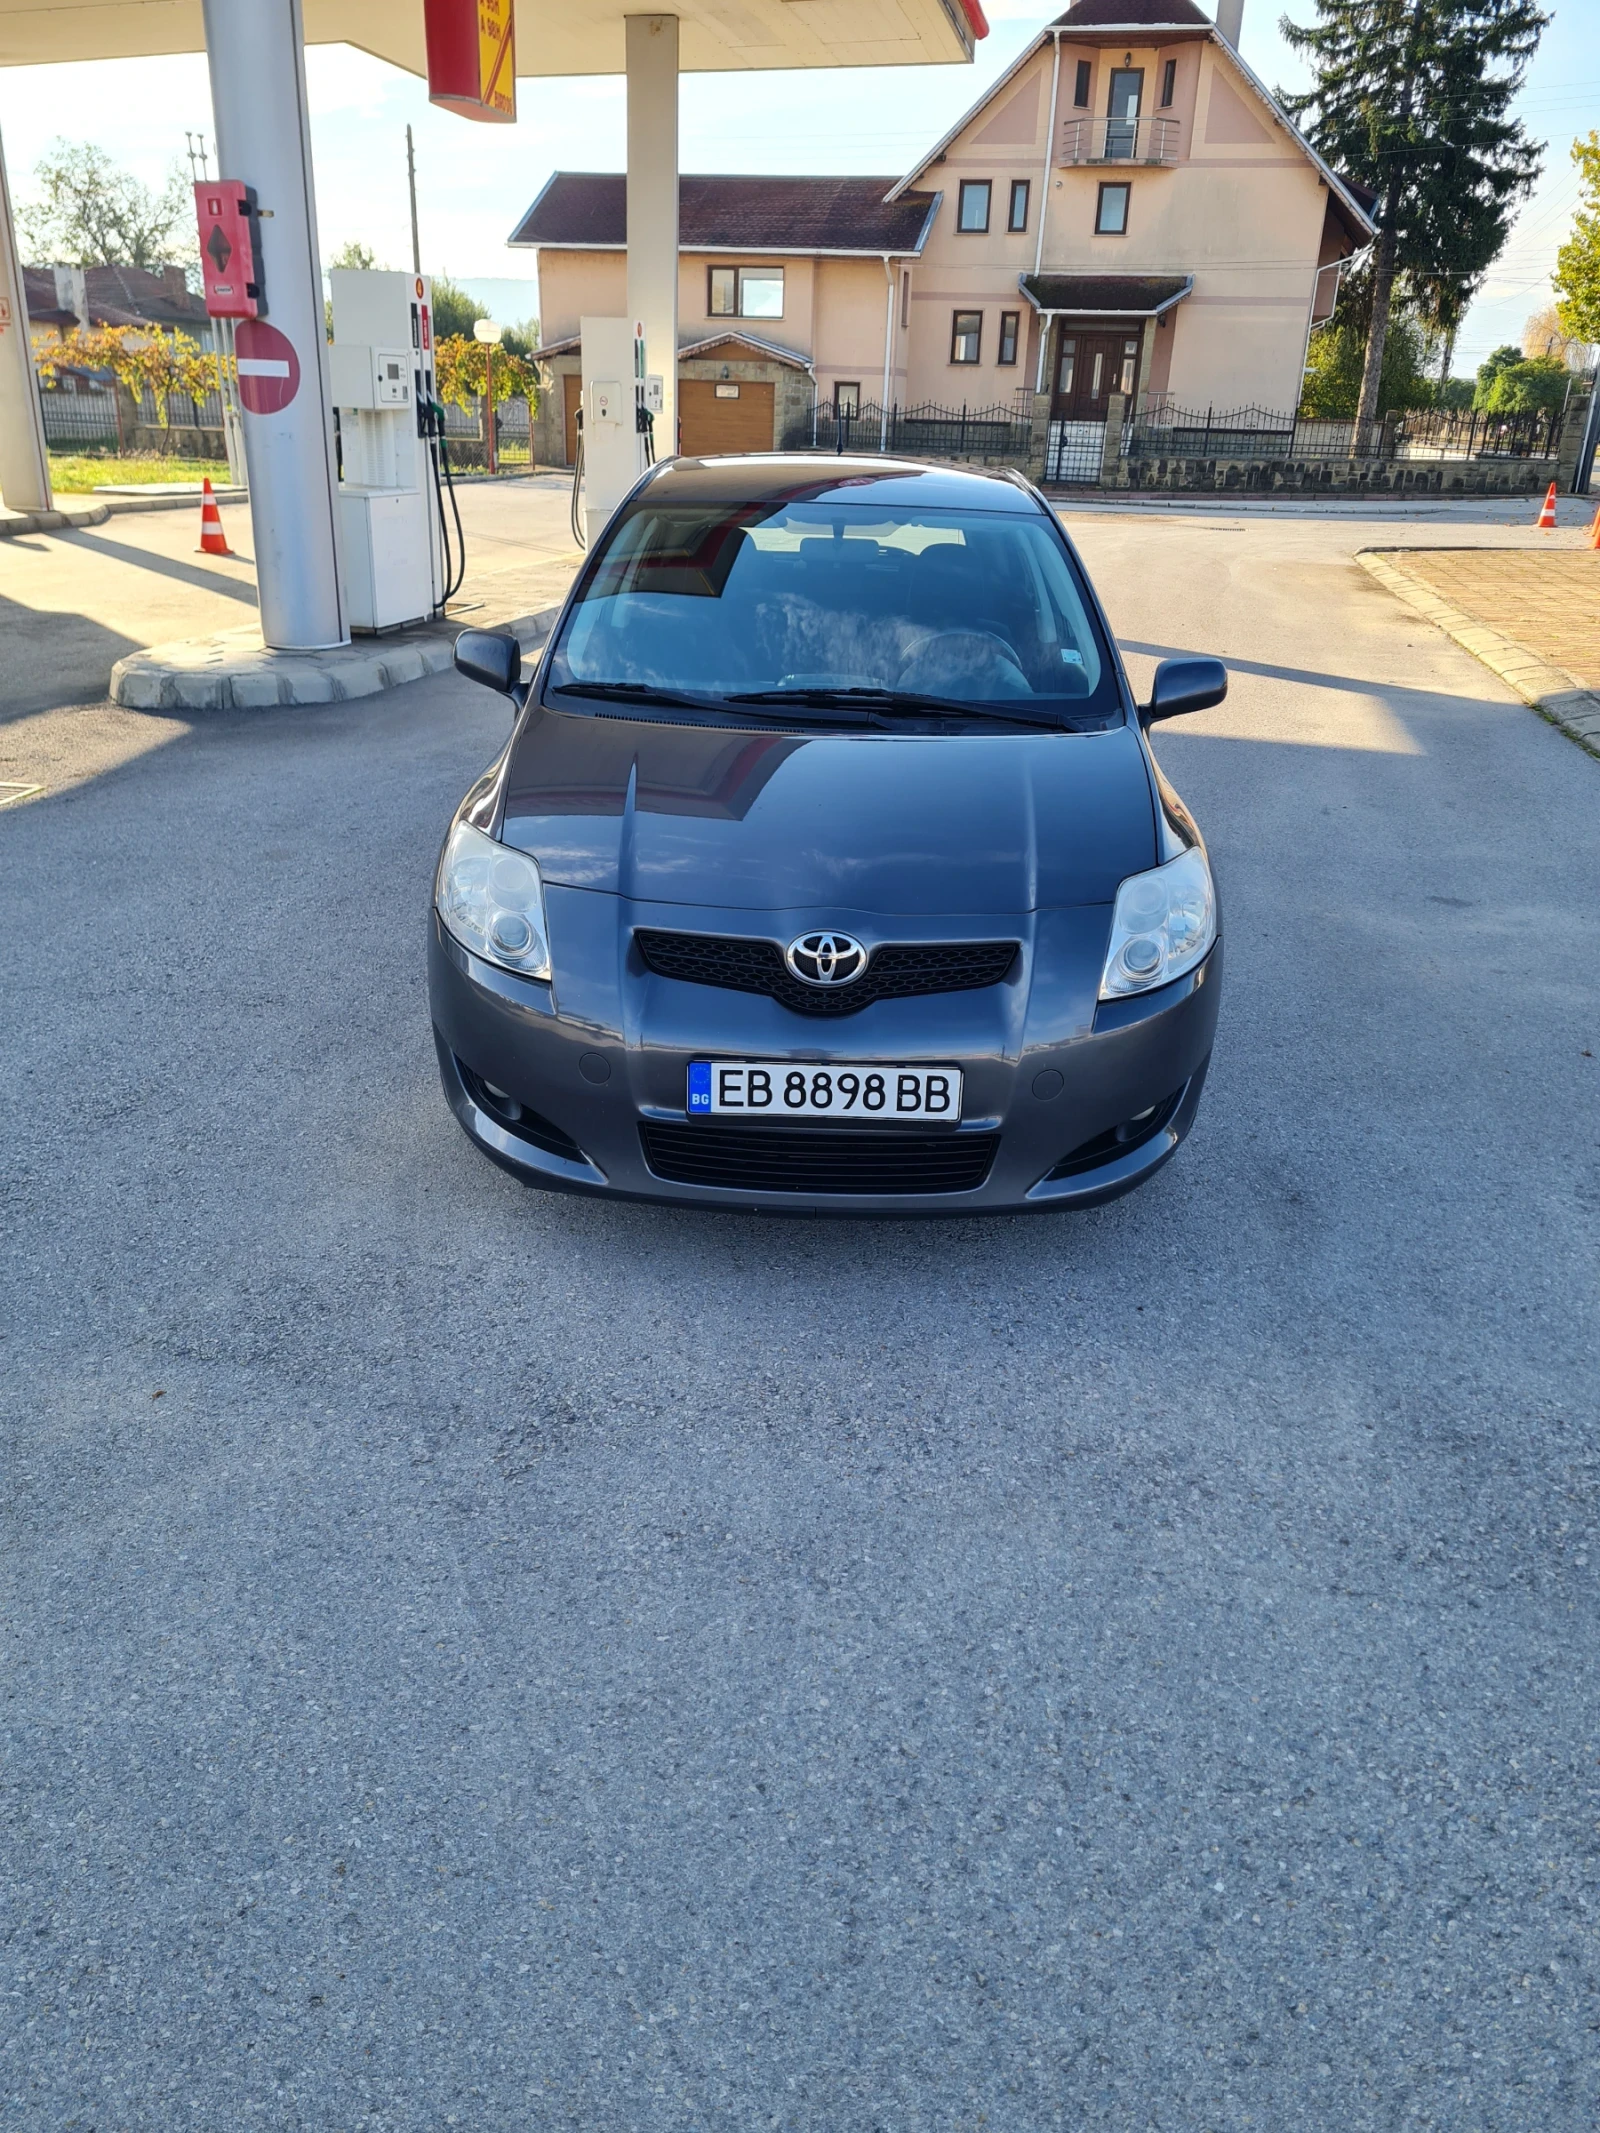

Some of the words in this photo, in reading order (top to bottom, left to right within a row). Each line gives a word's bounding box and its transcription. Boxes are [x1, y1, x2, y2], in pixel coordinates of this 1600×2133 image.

[480, 14, 487, 34] A
[691, 1093, 709, 1105] BG
[719, 1069, 773, 1107] EB
[783, 1071, 886, 1111] 8898
[896, 1074, 951, 1113] BB
